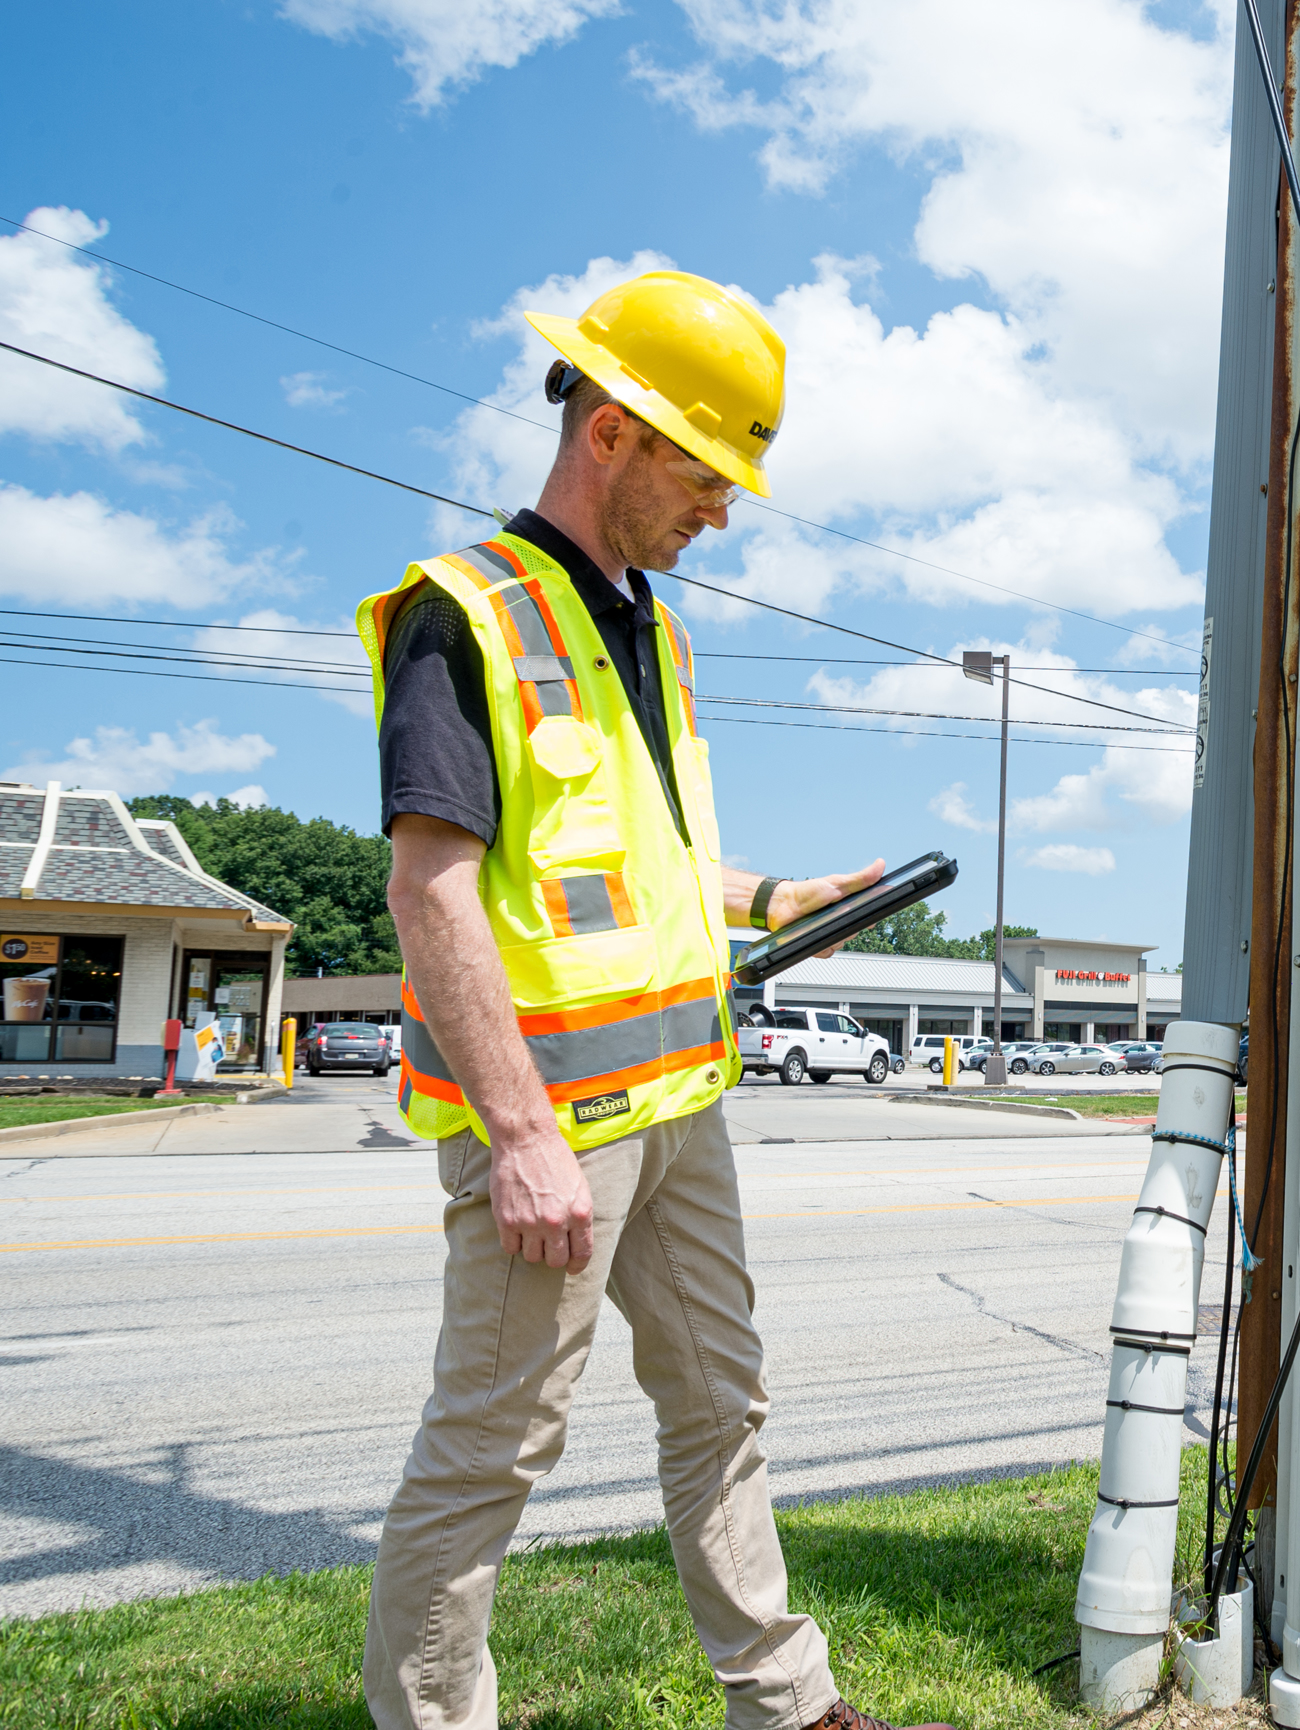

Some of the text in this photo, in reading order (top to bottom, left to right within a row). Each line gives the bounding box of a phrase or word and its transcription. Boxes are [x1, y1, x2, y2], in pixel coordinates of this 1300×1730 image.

[1078, 971, 1097, 980] Grill
[1104, 972, 1131, 981] Buffet
[582, 1101, 623, 1114] RADWEAR
